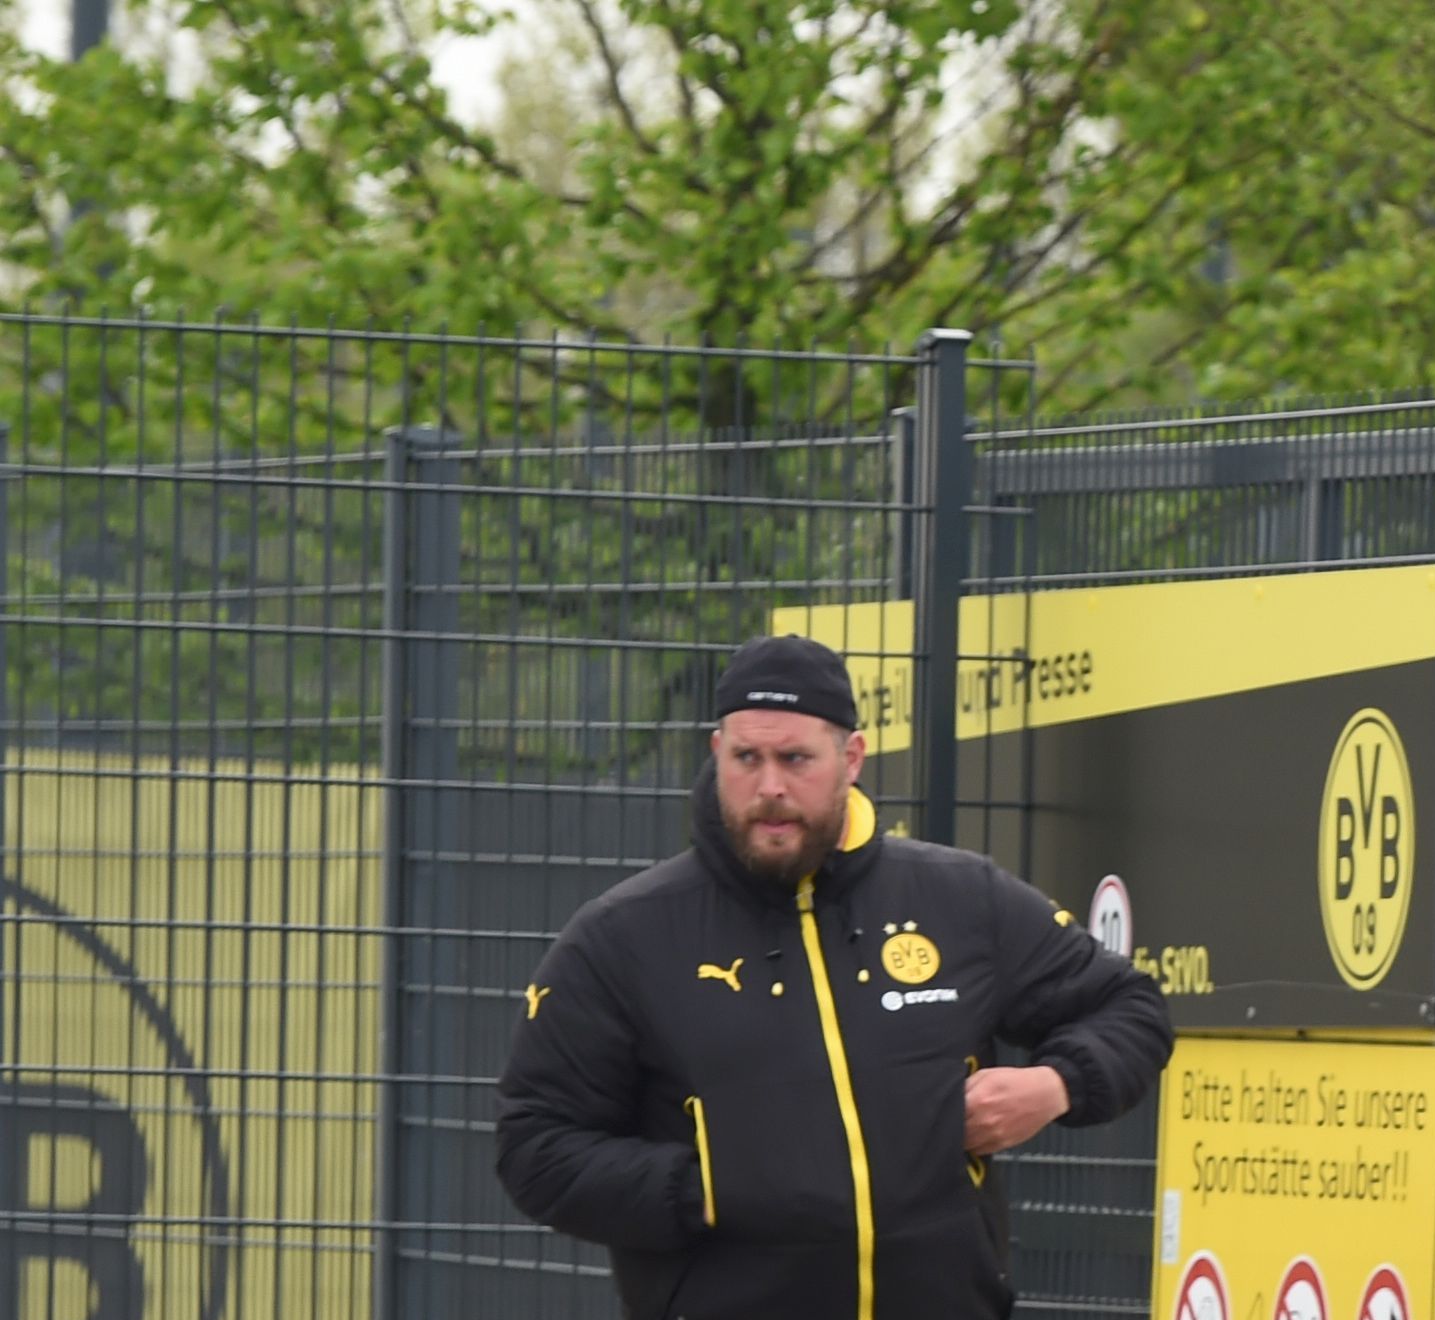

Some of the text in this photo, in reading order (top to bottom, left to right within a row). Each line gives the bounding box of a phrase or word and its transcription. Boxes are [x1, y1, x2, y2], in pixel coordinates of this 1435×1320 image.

[1011, 646, 1093, 706] Presse
[1335, 744, 1400, 900] BVB
[891, 941, 931, 969] BVB
[1352, 903, 1377, 955] 09
[1160, 946, 1215, 994] StVO.
[1182, 1069, 1427, 1130] Bitte halten Sie unsere
[1191, 1141, 1409, 1206] Sportstätte sauber!!
